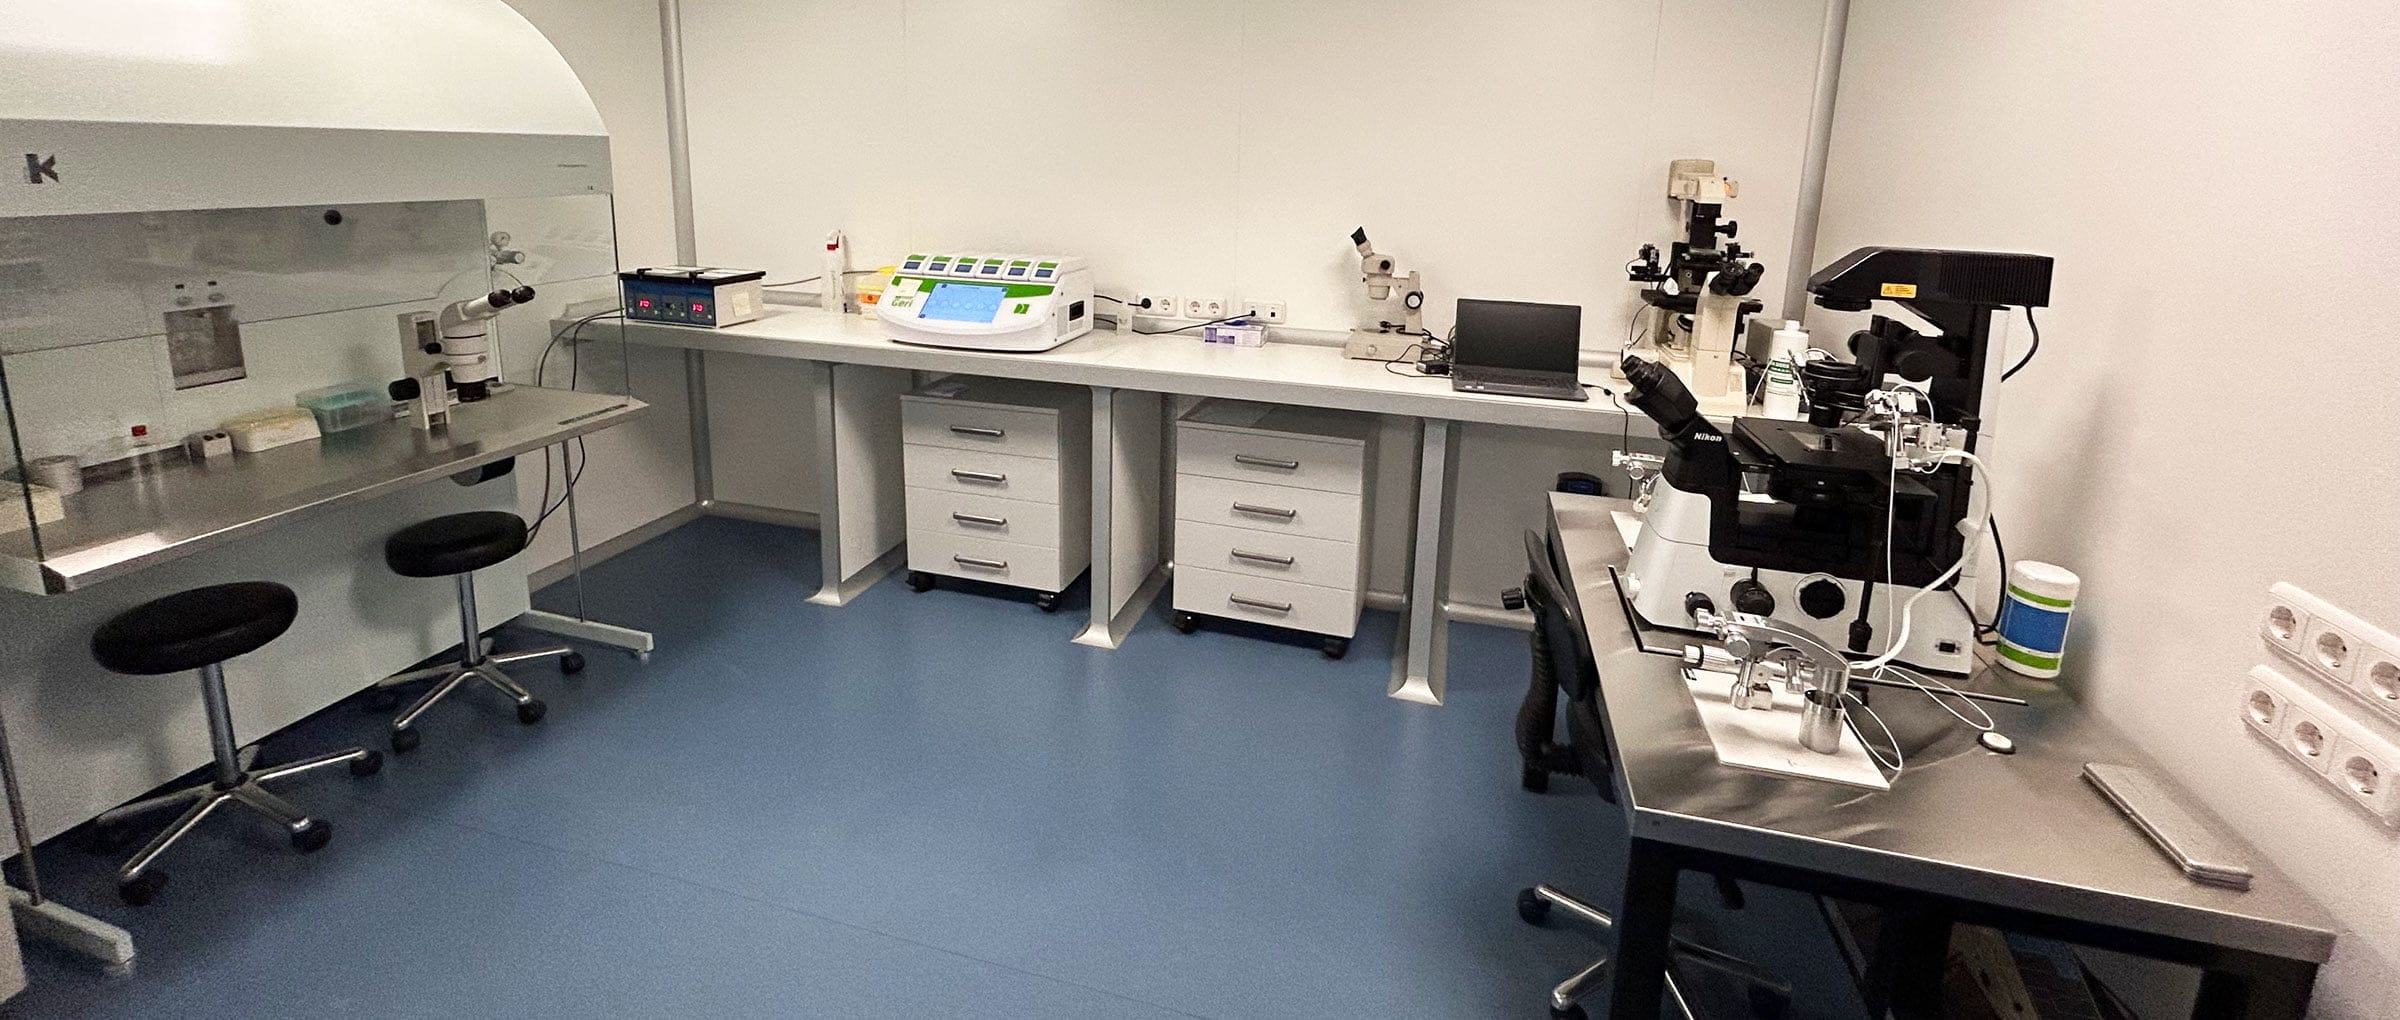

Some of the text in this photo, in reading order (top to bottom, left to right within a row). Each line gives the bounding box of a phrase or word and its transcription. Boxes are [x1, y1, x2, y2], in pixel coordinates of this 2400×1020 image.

[25, 153, 59, 184] K
[891, 299, 914, 308] Geri
[1693, 432, 1723, 442] Nikon
